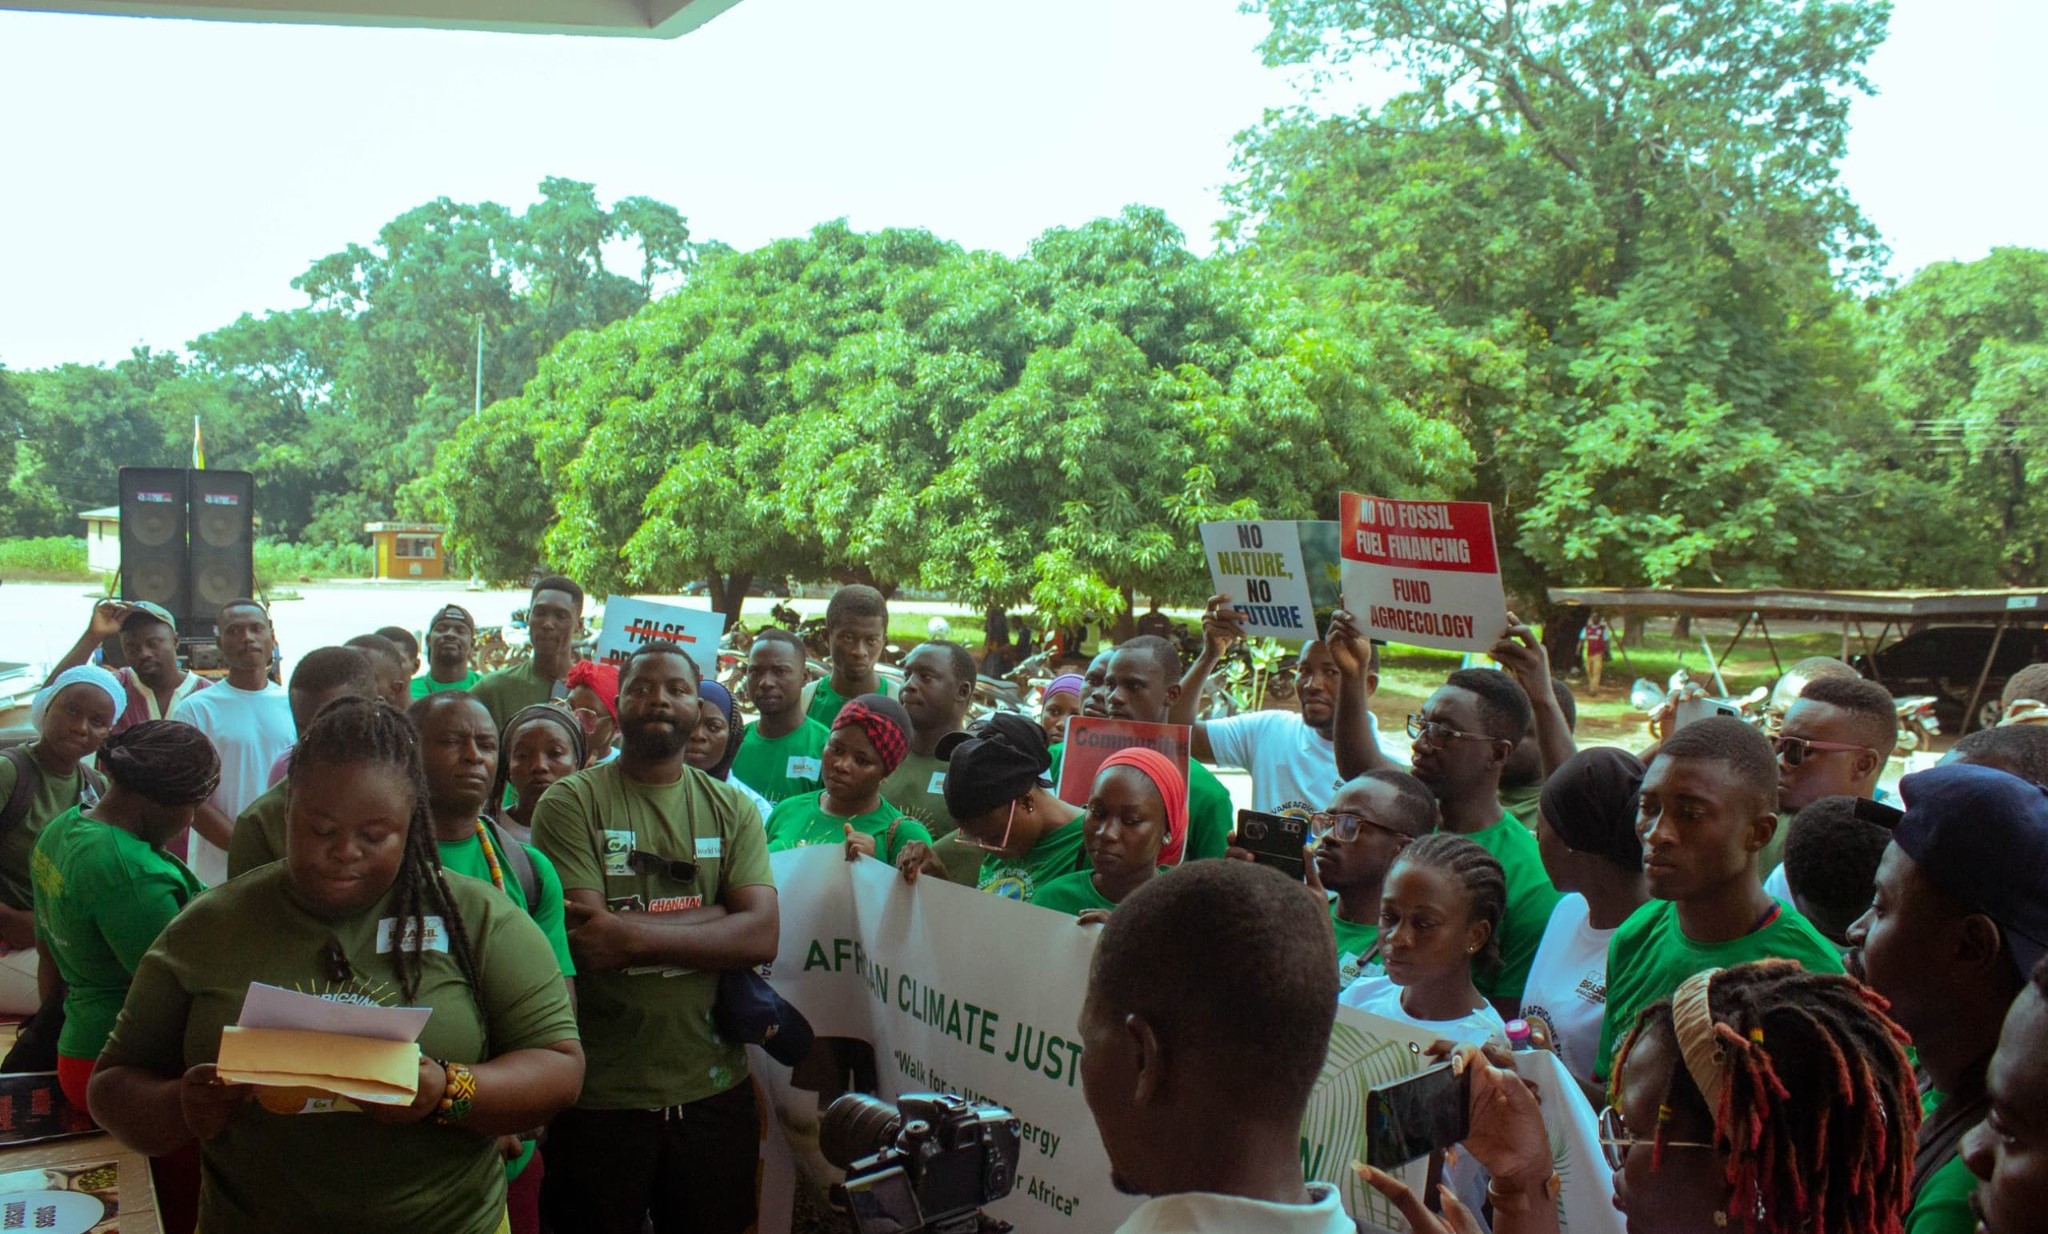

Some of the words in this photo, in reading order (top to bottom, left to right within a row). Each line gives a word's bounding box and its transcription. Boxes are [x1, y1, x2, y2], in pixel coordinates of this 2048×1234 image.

[1361, 499, 1375, 523] NO
[1378, 502, 1395, 527] TO
[1398, 503, 1454, 531] FOSSIL
[1237, 524, 1263, 549] NO
[1356, 529, 1386, 557] FUEL
[1387, 534, 1471, 564] FINANCING
[1217, 551, 1293, 580] NATURE,
[1246, 579, 1272, 603] NO
[1392, 578, 1431, 604] FUND
[1370, 605, 1473, 638] AGROECOLOGY
[898, 974, 999, 1054] CLIMATE
[929, 1069, 947, 1094] for
[1021, 1121, 1060, 1158] ergy
[3, 1201, 26, 1230] peasant
[33, 1205, 57, 1229] seeds
